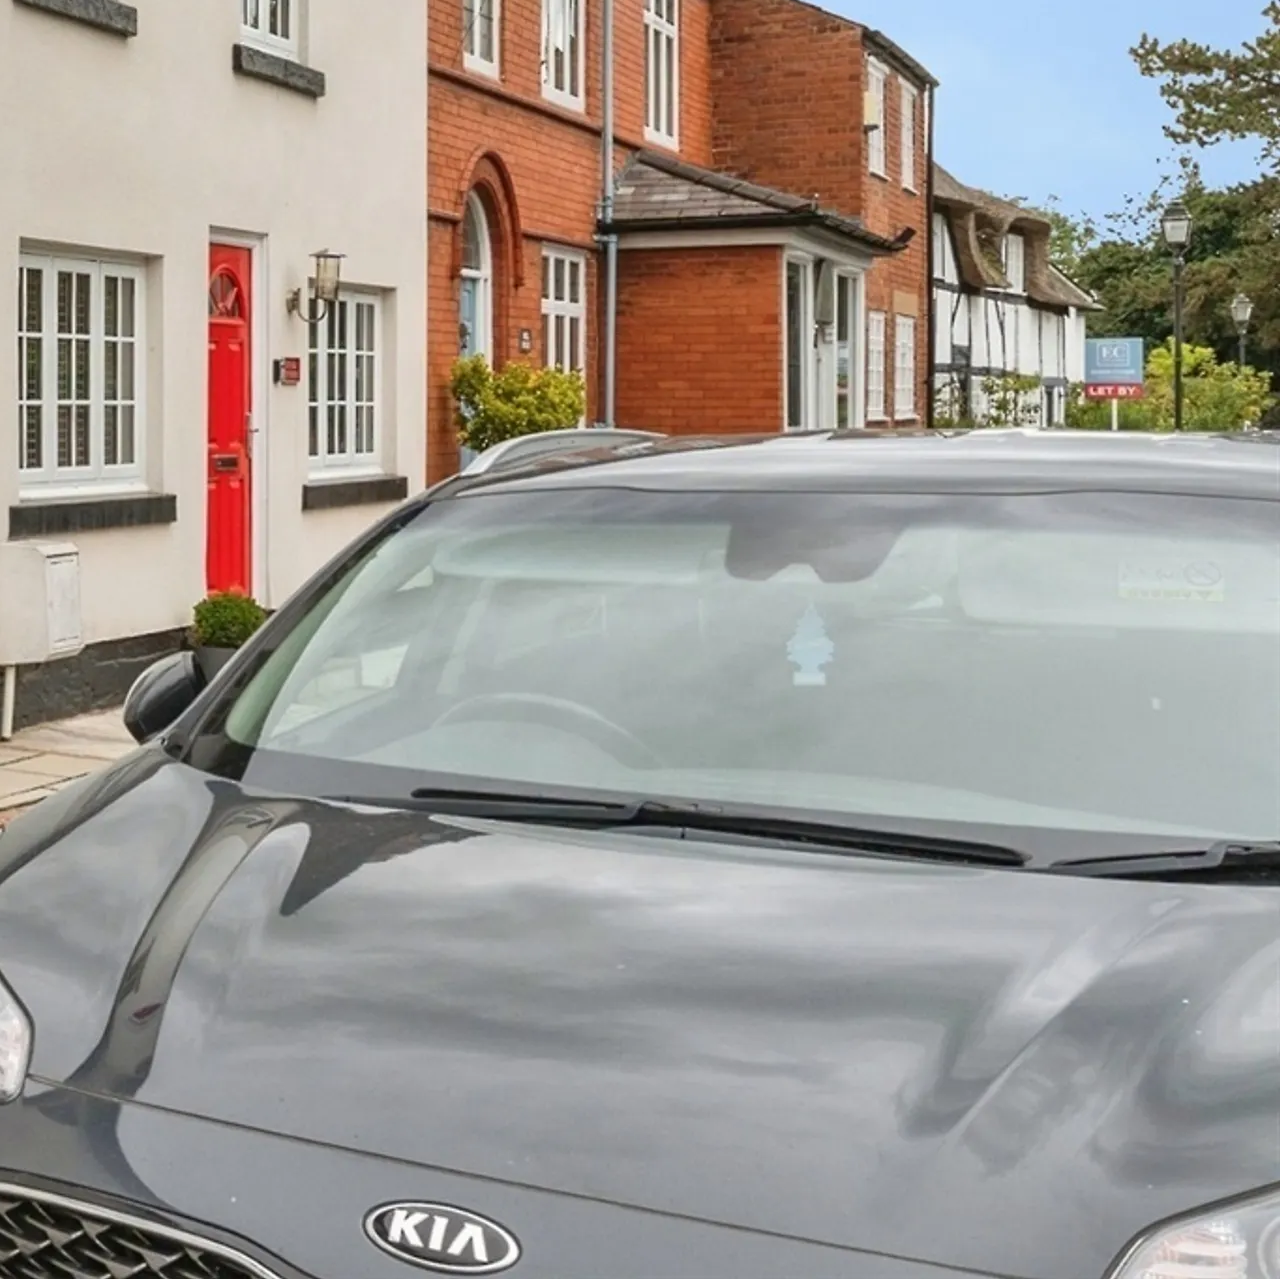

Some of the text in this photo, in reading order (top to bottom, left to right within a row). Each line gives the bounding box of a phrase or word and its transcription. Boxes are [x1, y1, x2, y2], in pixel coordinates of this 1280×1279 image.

[1089, 385, 1137, 396] LET BY
[388, 1208, 489, 1263] KIA
